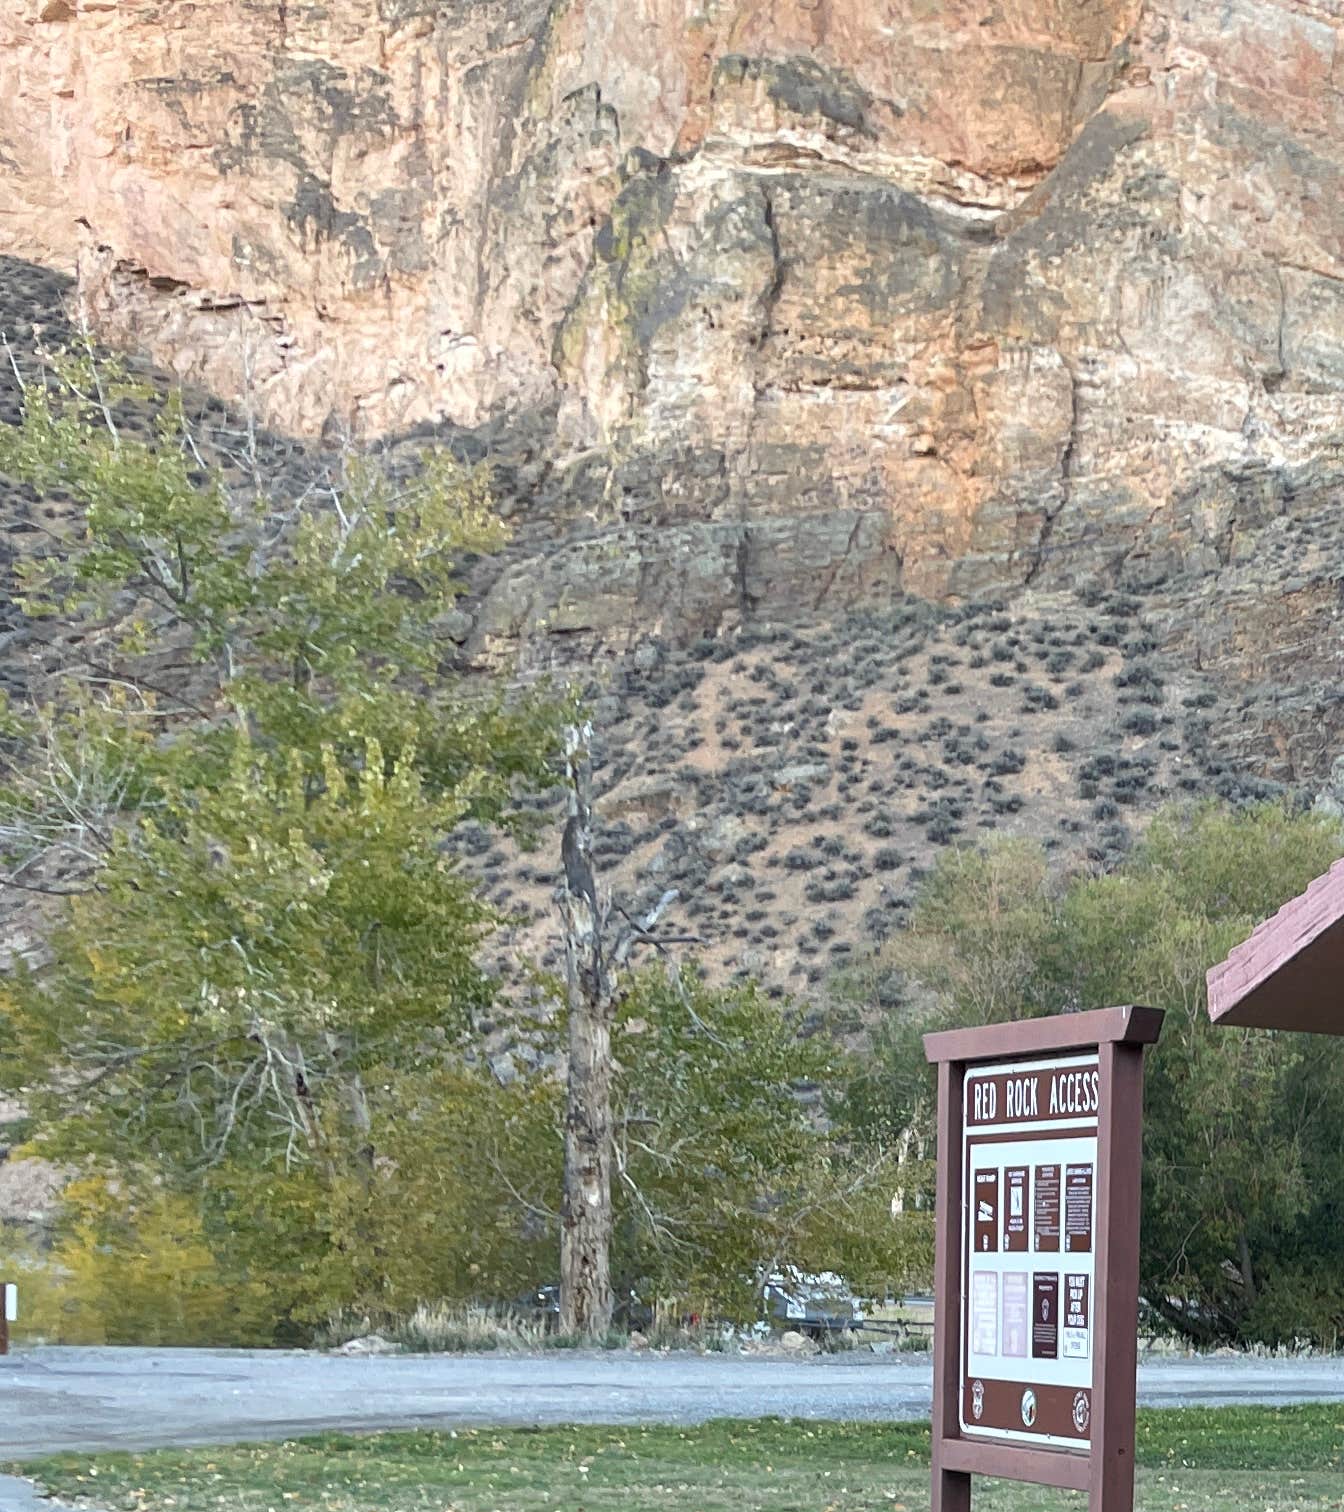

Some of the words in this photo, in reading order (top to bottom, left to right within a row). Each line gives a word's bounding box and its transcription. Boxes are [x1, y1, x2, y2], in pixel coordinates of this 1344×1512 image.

[975, 1082, 997, 1120] RED
[1006, 1077, 1038, 1118] ROCK
[1049, 1071, 1099, 1114] ACCESS
